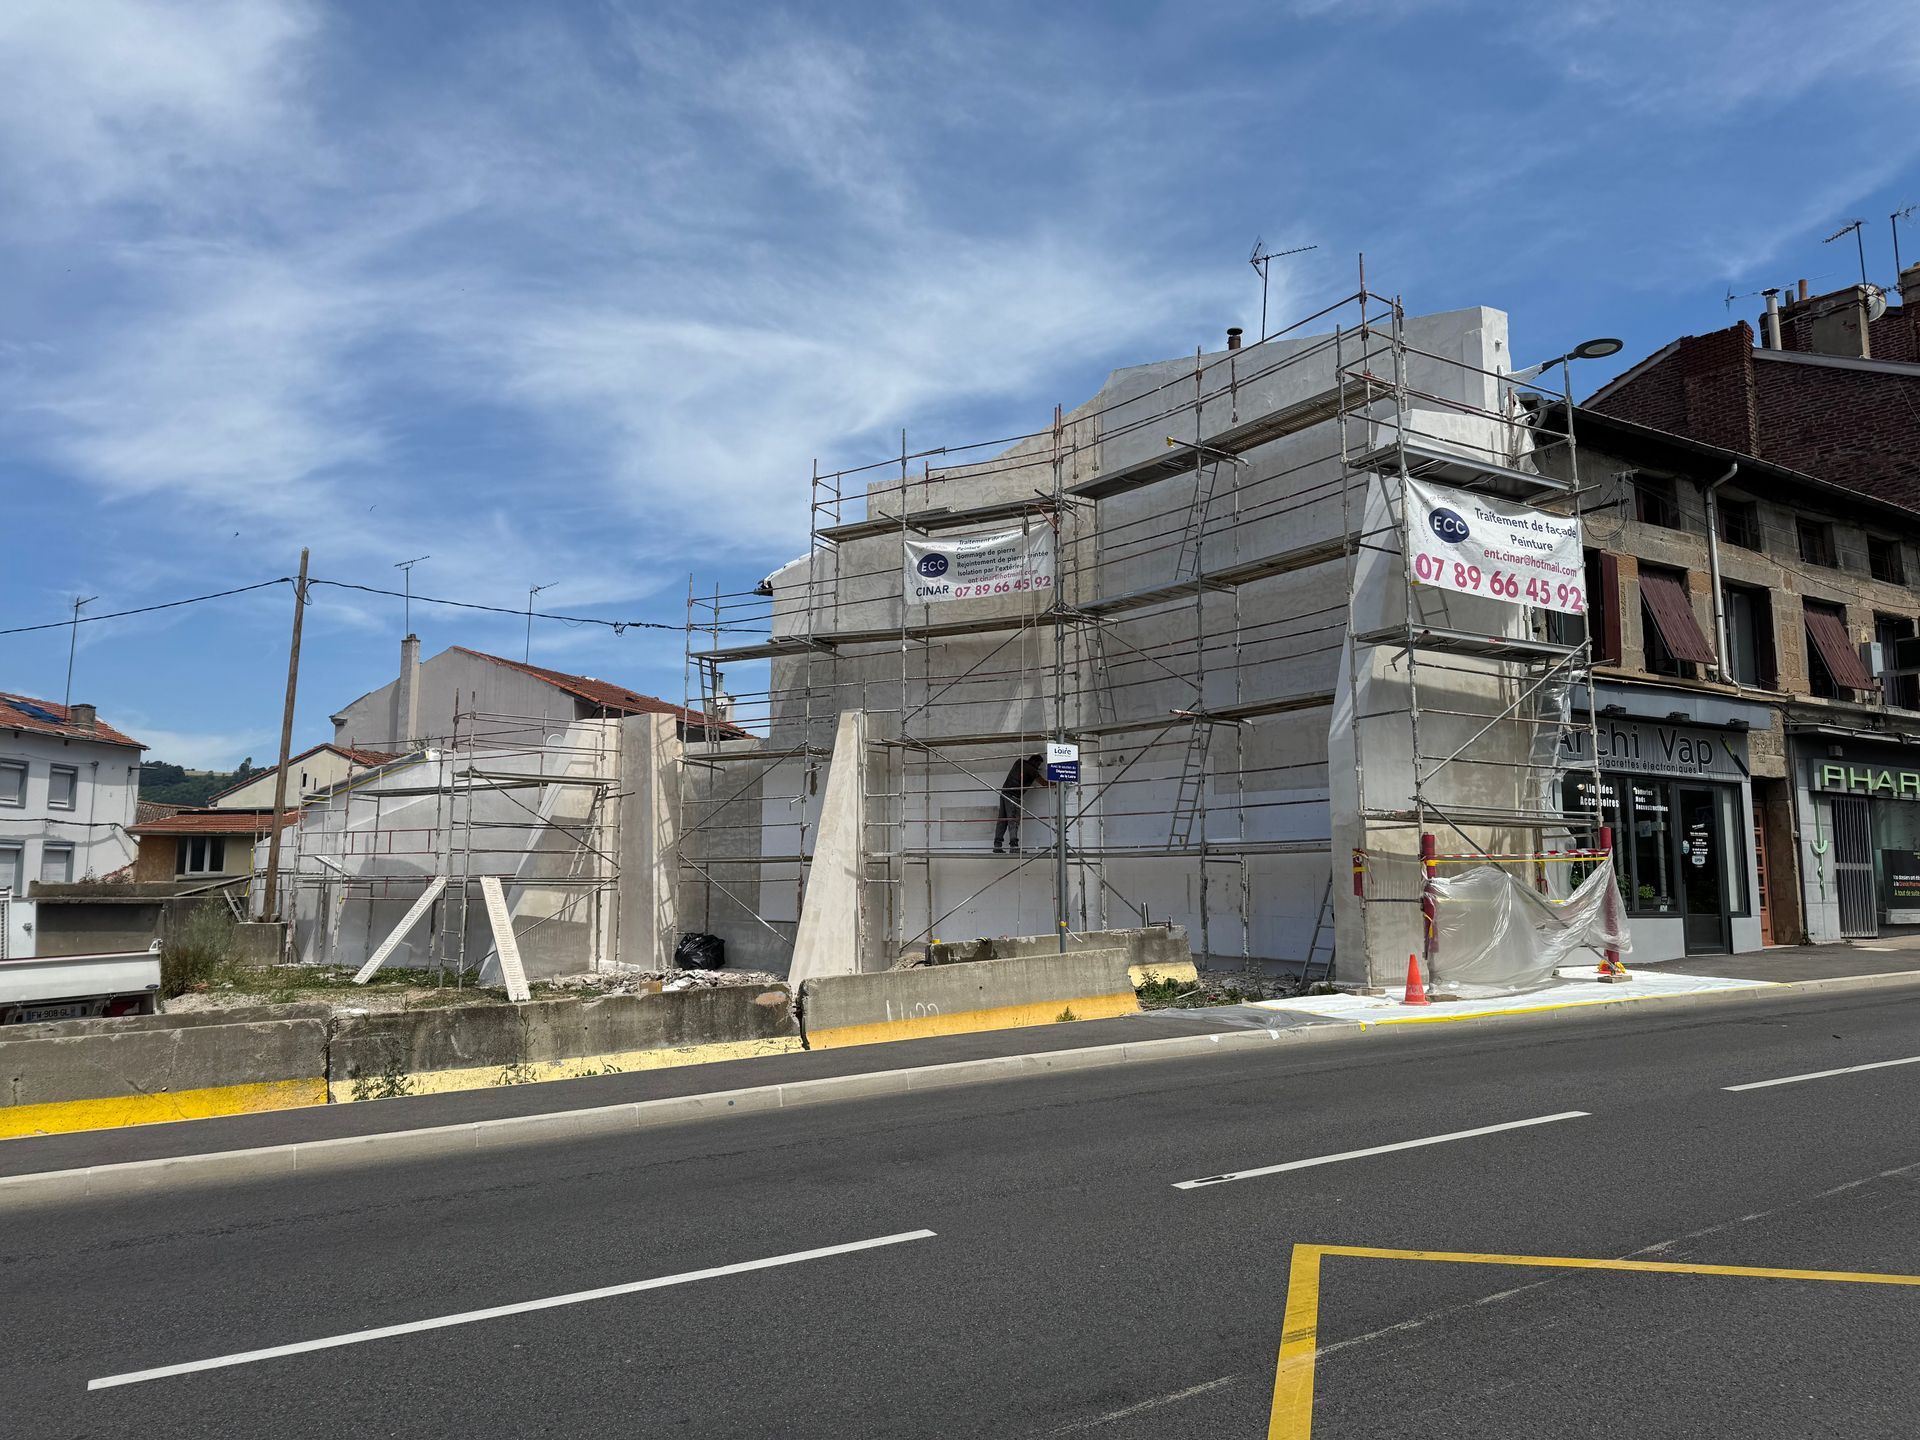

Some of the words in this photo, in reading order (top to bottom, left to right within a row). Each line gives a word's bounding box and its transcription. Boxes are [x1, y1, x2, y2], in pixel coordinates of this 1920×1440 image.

[1433, 515, 1467, 535] ECC
[1474, 507, 1529, 530] Traitement
[1531, 519, 1544, 533] de
[1545, 522, 1577, 538] façade
[1510, 534, 1554, 552] Peinture
[956, 550, 986, 560] Gommage
[988, 548, 996, 556] de
[997, 546, 1016, 556] pierre
[957, 557, 996, 569] Rejointement
[998, 556, 1006, 564] de
[921, 560, 945, 572] ECC
[958, 568, 982, 577] Isolation
[984, 567, 994, 575] par
[1483, 548, 1577, 578] ent.cinar@hotmail.com
[916, 584, 949, 597] CINAR
[954, 586, 971, 598] 07
[975, 584, 990, 596] 89
[994, 581, 1010, 593] 66
[1013, 578, 1030, 590] 45
[1034, 575, 1052, 587] 92
[1415, 552, 1445, 582] 07
[1453, 561, 1482, 591] 89
[1489, 570, 1519, 598] 66
[1525, 577, 1551, 605] 45
[1557, 583, 1583, 611] 92
[1657, 727, 1713, 775] Vap
[1598, 757, 1640, 770] Cigarettes
[1643, 760, 1697, 774] électroniques
